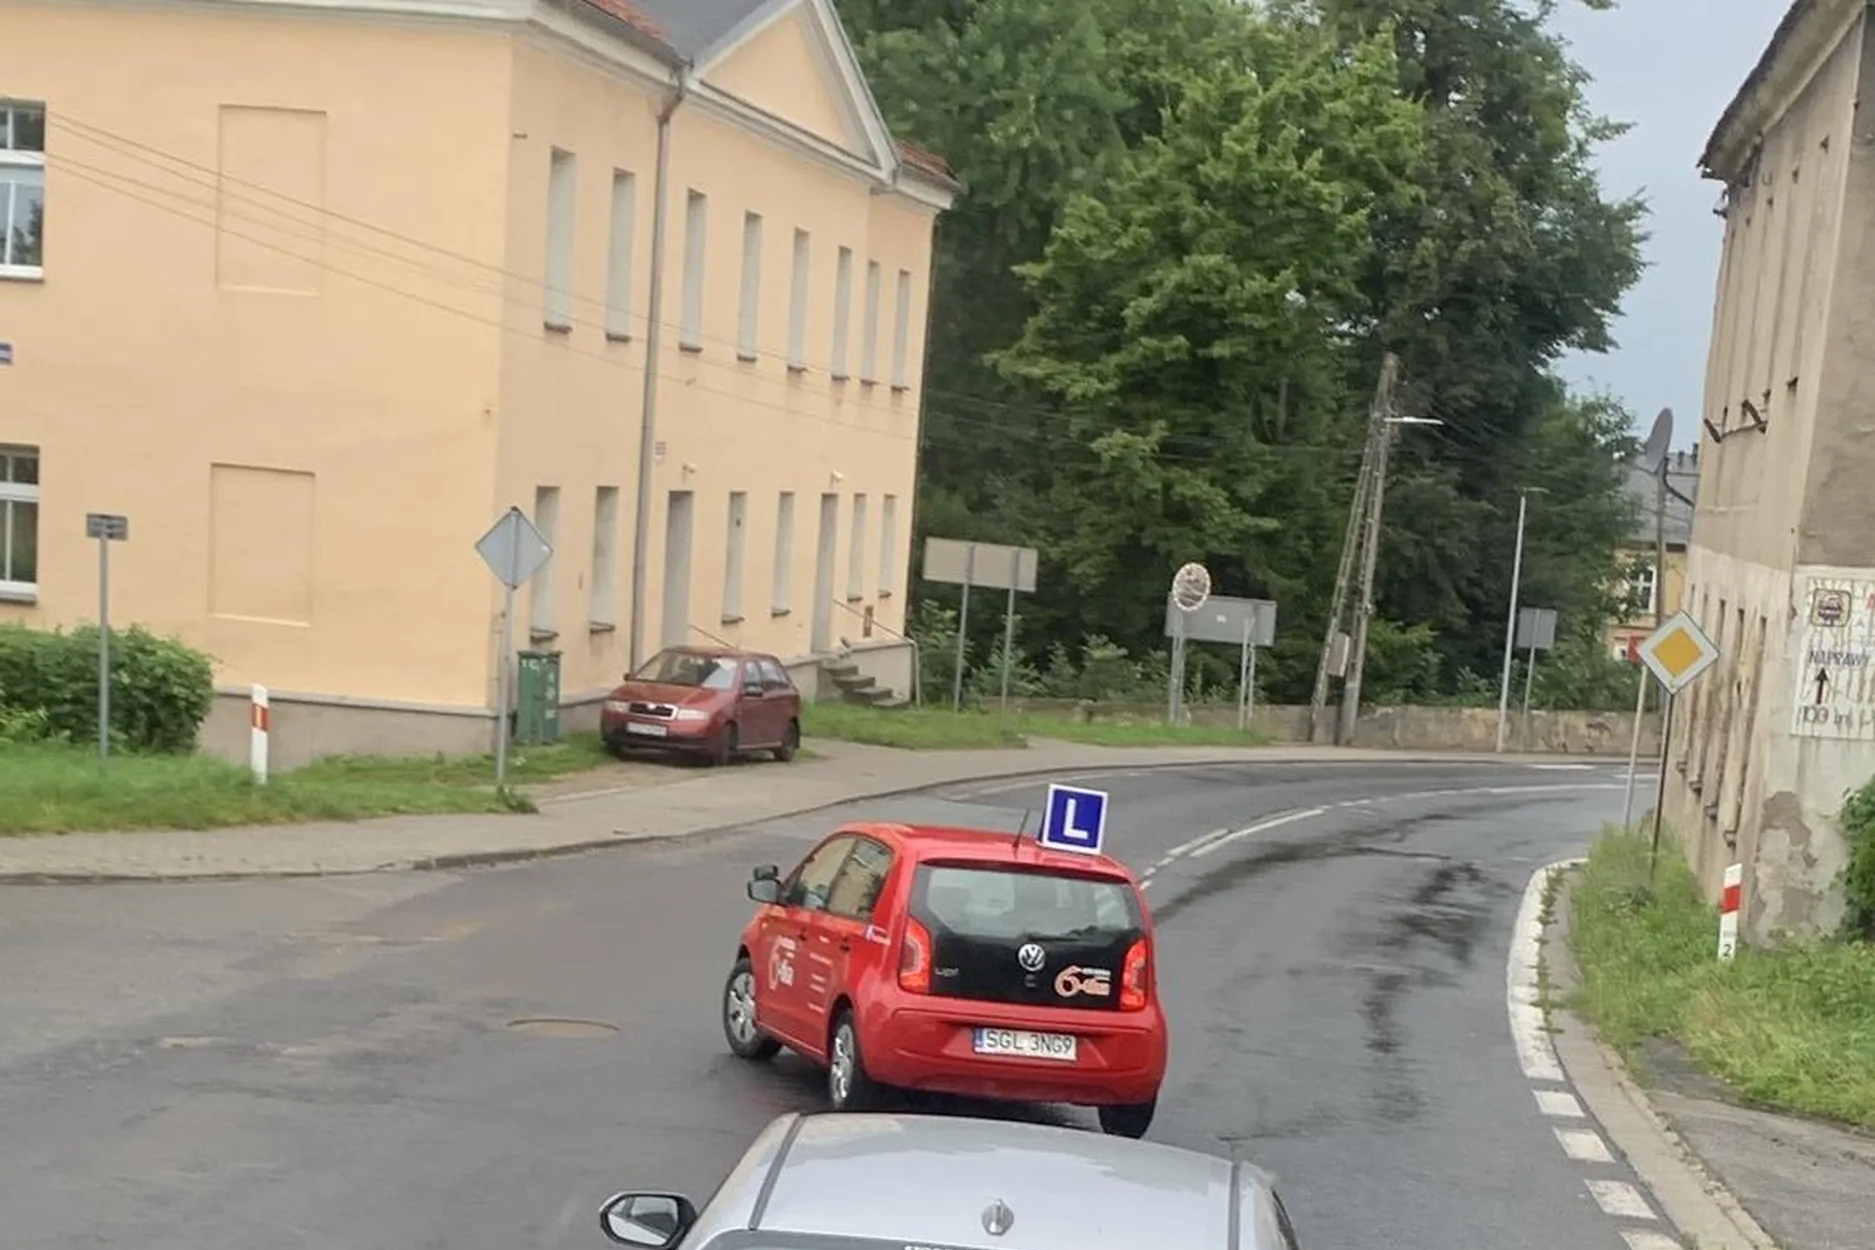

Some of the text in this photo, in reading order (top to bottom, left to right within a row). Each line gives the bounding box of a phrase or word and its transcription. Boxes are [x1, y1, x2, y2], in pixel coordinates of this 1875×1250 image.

[1063, 798, 1089, 839] L
[986, 1030, 1072, 1054] SGL 3NG9
